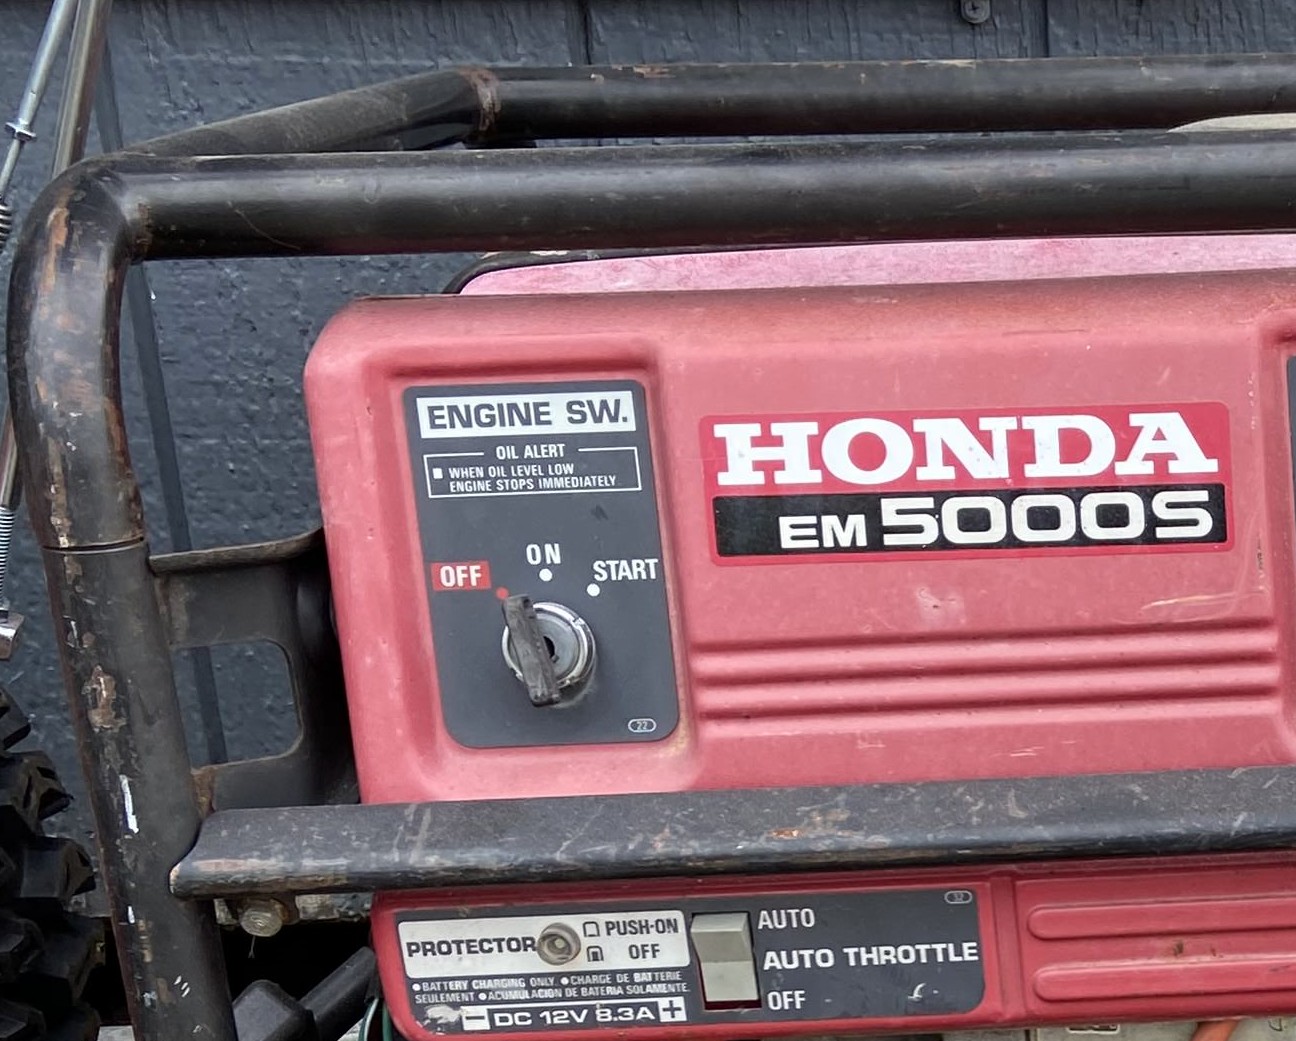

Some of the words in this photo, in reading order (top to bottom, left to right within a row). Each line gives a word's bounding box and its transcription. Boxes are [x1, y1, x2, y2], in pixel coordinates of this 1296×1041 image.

[427, 402, 552, 429] ENGINE
[566, 399, 629, 424] SW.
[496, 446, 519, 460] OIL
[524, 444, 565, 458] ALERT
[714, 412, 1218, 485] HONDA
[449, 467, 484, 478] WHEN
[488, 466, 507, 477] OIL
[511, 465, 544, 476] LEVEL
[548, 464, 574, 475] LOW
[450, 480, 492, 492] ENGINE
[496, 478, 534, 491] STOPS
[539, 476, 616, 489] IMMEDIATELY
[779, 514, 867, 548] EM
[880, 490, 1213, 545] 5000S
[526, 544, 562, 565] ON
[440, 565, 482, 587] OFF
[593, 559, 658, 581] START
[605, 918, 679, 936] PUSH-ON
[758, 908, 815, 929] AUTO
[406, 936, 536, 957] PROTECTOR
[628, 943, 660, 960] OFF
[763, 949, 834, 970] AUTO
[843, 942, 979, 966] THROTTLE
[422, 980, 469, 991] BATTERY
[472, 978, 526, 989] CHARGING
[570, 974, 612, 985] CHARGE
[616, 973, 629, 983] DE
[633, 971, 682, 982] BATTERIE
[415, 992, 475, 1003] SEULEMENT
[565, 987, 578, 997] DE
[581, 985, 624, 996] BATERIA
[767, 990, 806, 1011] OFF
[494, 1011, 532, 1026] DC
[540, 1009, 588, 1024] 12V
[595, 1007, 655, 1022] 8.3A
